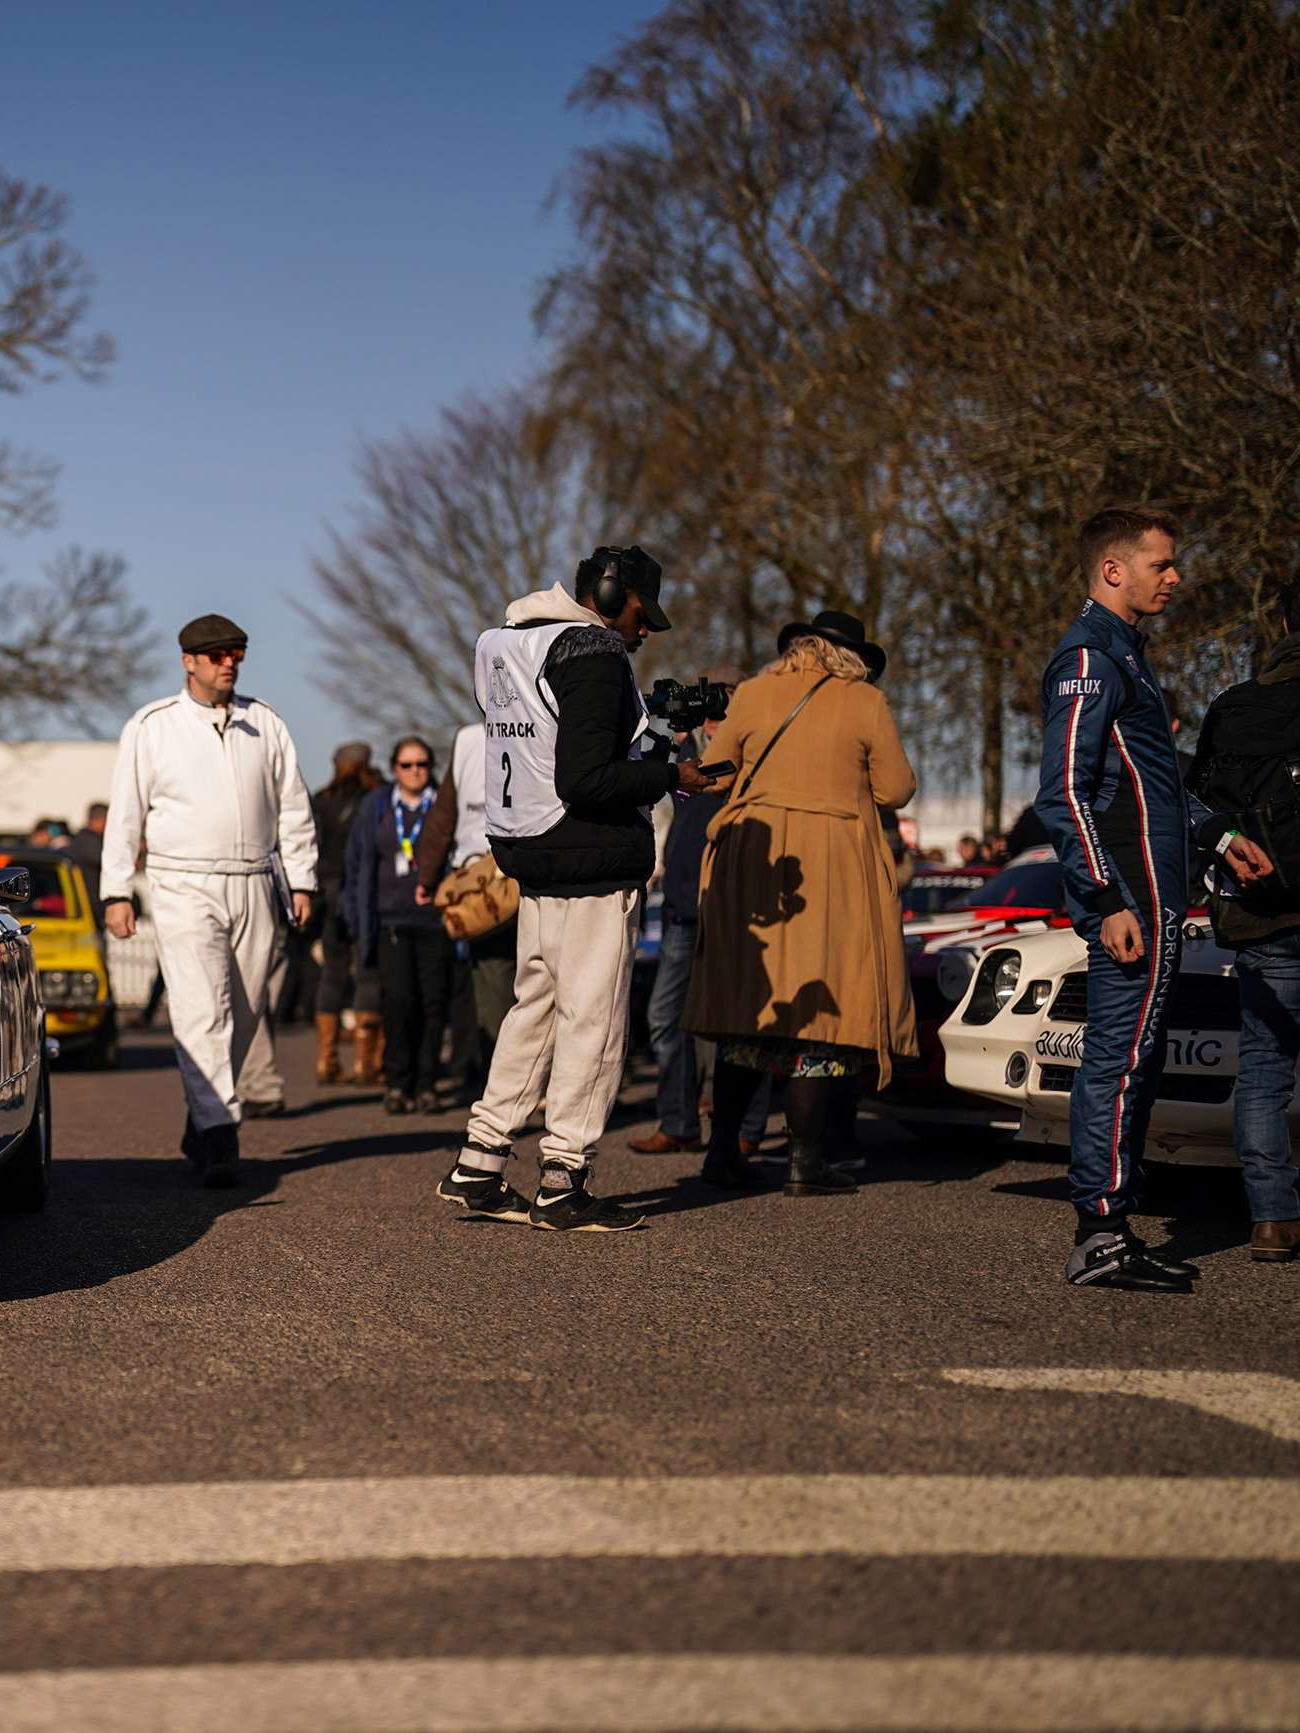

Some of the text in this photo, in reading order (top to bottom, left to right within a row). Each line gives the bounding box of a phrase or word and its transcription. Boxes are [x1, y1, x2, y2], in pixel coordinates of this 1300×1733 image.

[1058, 679, 1102, 697] INFLUX
[496, 722, 536, 739] TRACK
[501, 751, 512, 809] 2
[1096, 847, 1110, 879] MILLE
[1159, 906, 1179, 993] ADRIAN
